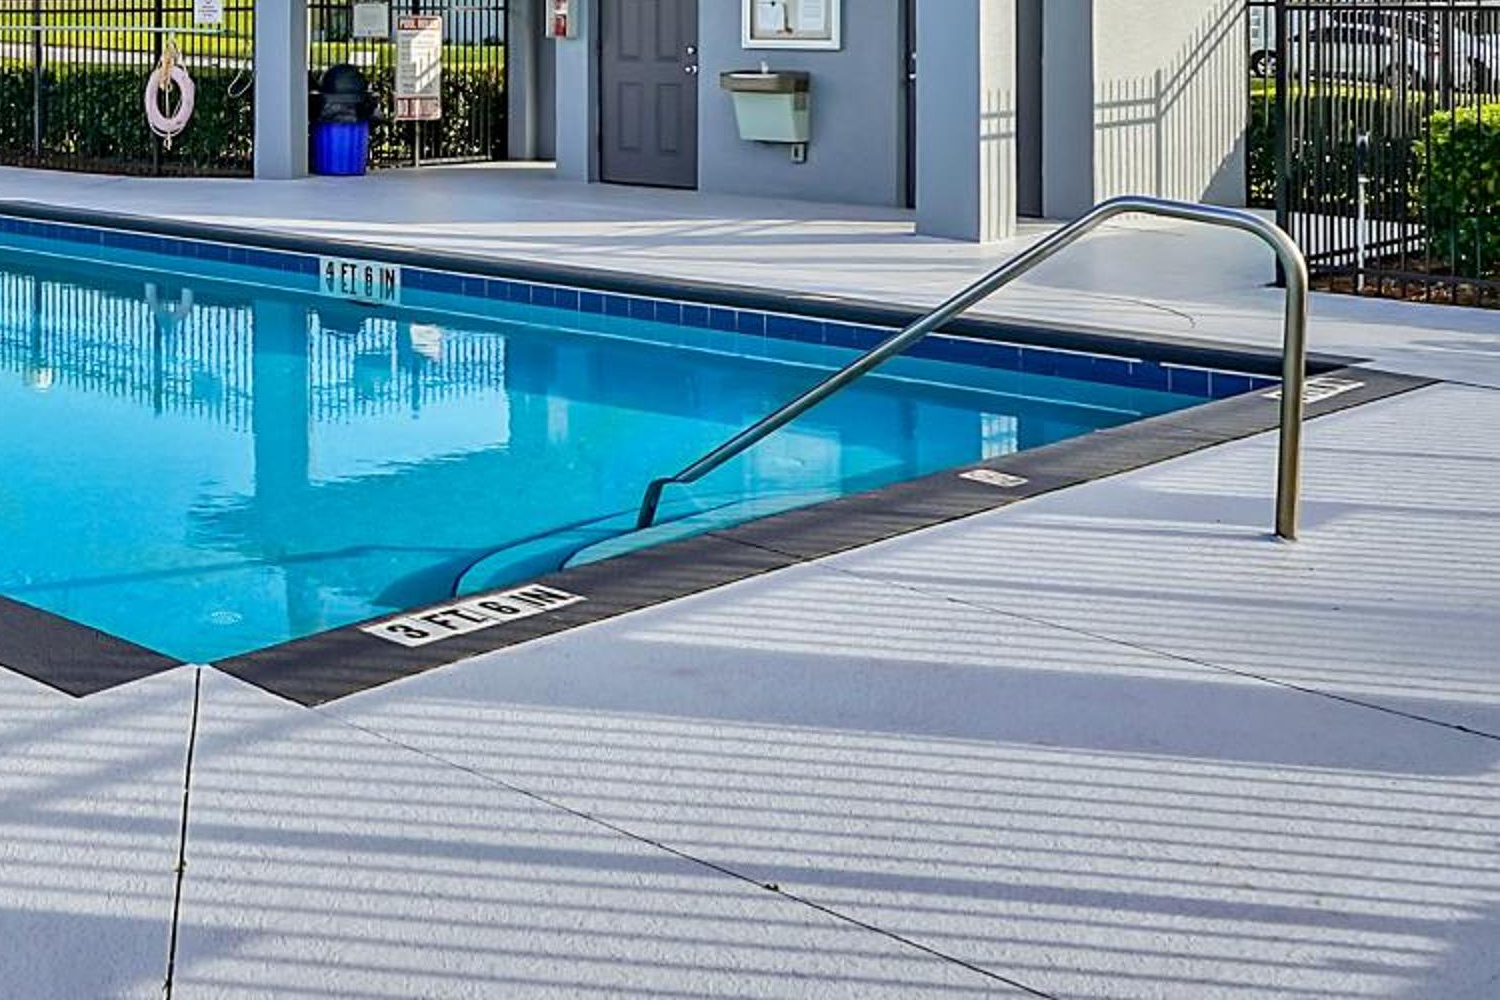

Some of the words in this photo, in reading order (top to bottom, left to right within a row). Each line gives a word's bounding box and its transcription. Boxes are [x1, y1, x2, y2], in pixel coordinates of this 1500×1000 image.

[386, 623, 430, 640] 3
[419, 609, 488, 631] FT
[478, 600, 521, 615] 6
[509, 587, 571, 608] IN
